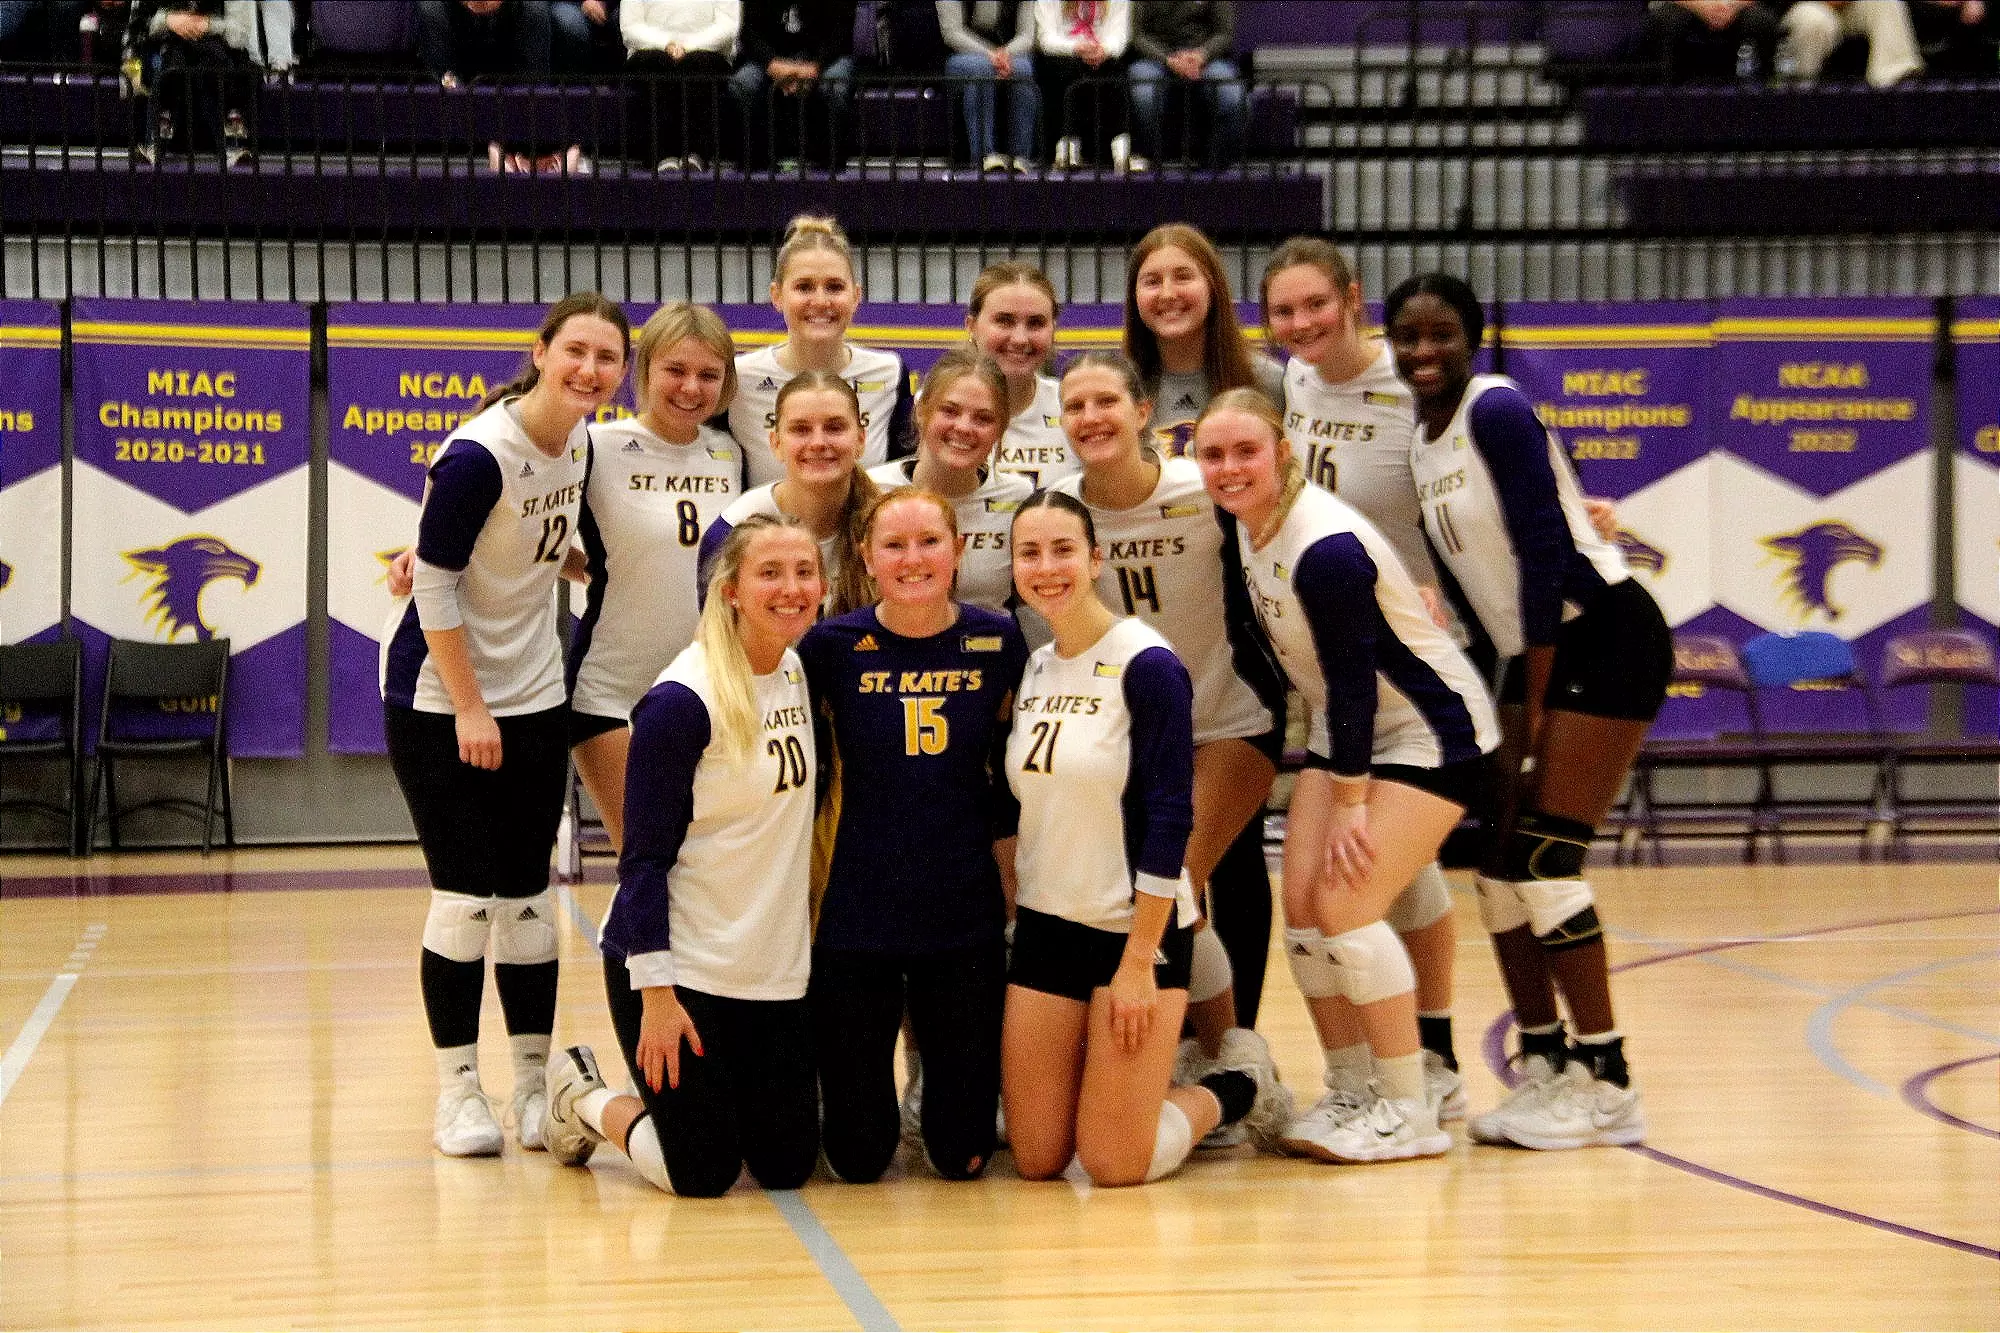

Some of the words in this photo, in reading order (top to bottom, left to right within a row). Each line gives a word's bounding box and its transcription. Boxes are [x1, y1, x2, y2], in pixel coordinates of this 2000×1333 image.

[148, 370, 236, 397] MIAC
[400, 372, 488, 399] NCAA
[1565, 370, 1648, 396] MIAC
[1779, 363, 1868, 388] NCAA
[99, 401, 282, 435] Champions
[343, 405, 474, 435] Appear
[1308, 419, 1375, 442] KATE'S
[1540, 403, 1690, 432] hampions
[115, 439, 265, 465] 2020-2021
[1305, 441, 1338, 493] 16
[628, 474, 657, 491] ST.
[665, 475, 729, 493] KATE'S
[521, 497, 539, 518] ST.
[676, 498, 700, 547] 8
[1434, 502, 1464, 553] 11
[533, 514, 568, 563] 12
[962, 532, 1006, 550] TE'S
[1110, 536, 1184, 560] KATE'S
[1115, 564, 1162, 616] 14
[858, 671, 892, 693] ST.
[898, 670, 982, 693] KATE'S
[764, 705, 807, 731] KATE'S
[1018, 695, 1041, 712] ST.
[1041, 695, 1102, 715] KATE'S
[899, 697, 947, 756] 15
[1022, 720, 1062, 775] 21
[767, 735, 807, 794] 20
